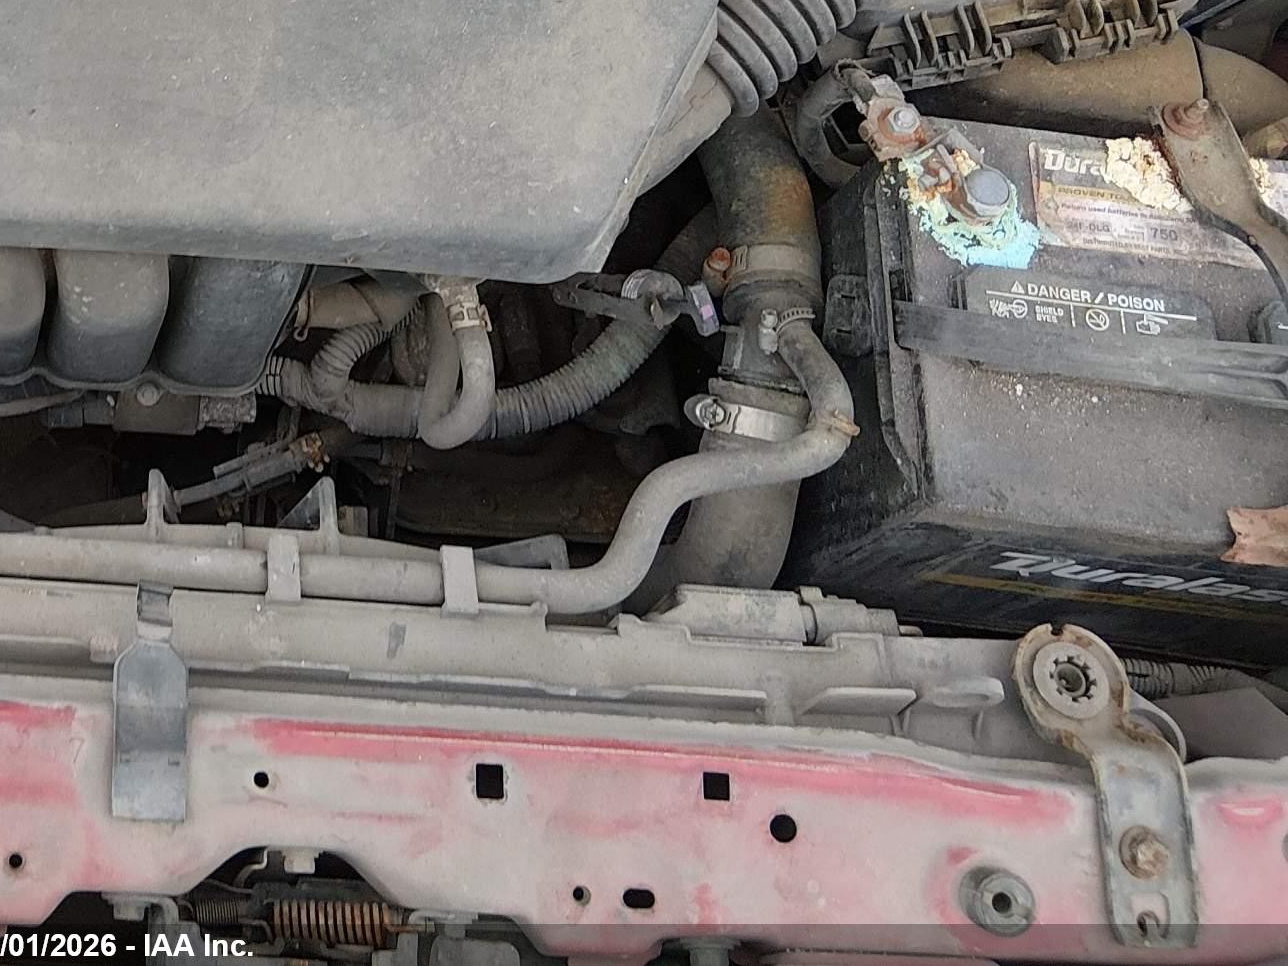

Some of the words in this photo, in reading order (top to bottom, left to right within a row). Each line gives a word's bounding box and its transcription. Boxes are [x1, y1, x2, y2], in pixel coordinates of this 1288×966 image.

[1058, 186, 1105, 199] PROVEN
[1088, 205, 1106, 213] used
[1107, 207, 1139, 218] batteries
[1150, 227, 1178, 241] 750
[1027, 283, 1092, 304] DANGER
[1107, 293, 1165, 312] POISON
[1035, 304, 1064, 317] SHIELD
[1036, 313, 1058, 323] EYES
[989, 550, 1288, 606] Duralas
